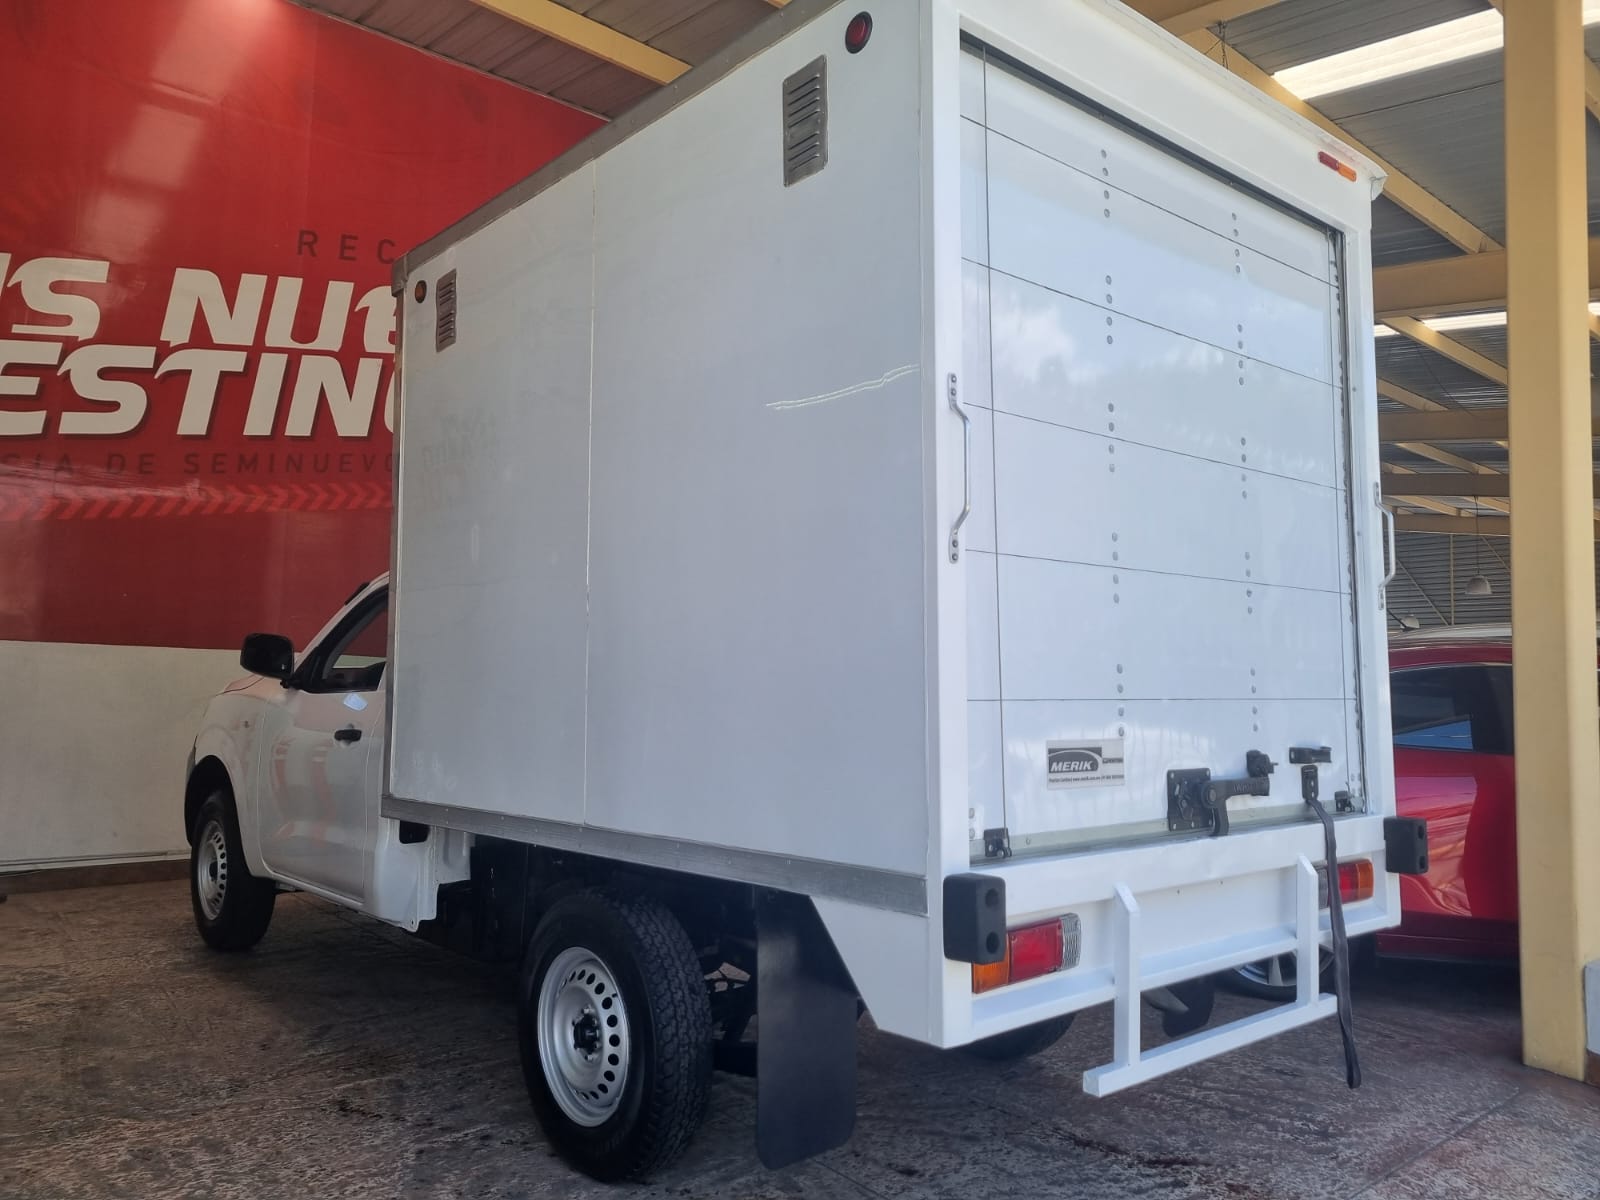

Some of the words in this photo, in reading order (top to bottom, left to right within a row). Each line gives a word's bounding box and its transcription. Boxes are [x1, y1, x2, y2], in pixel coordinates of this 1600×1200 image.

[0, 252, 110, 342] S
[0, 339, 394, 437] ESTIN
[107, 452, 156, 475] DE
[1050, 760, 1093, 772] MERIK
